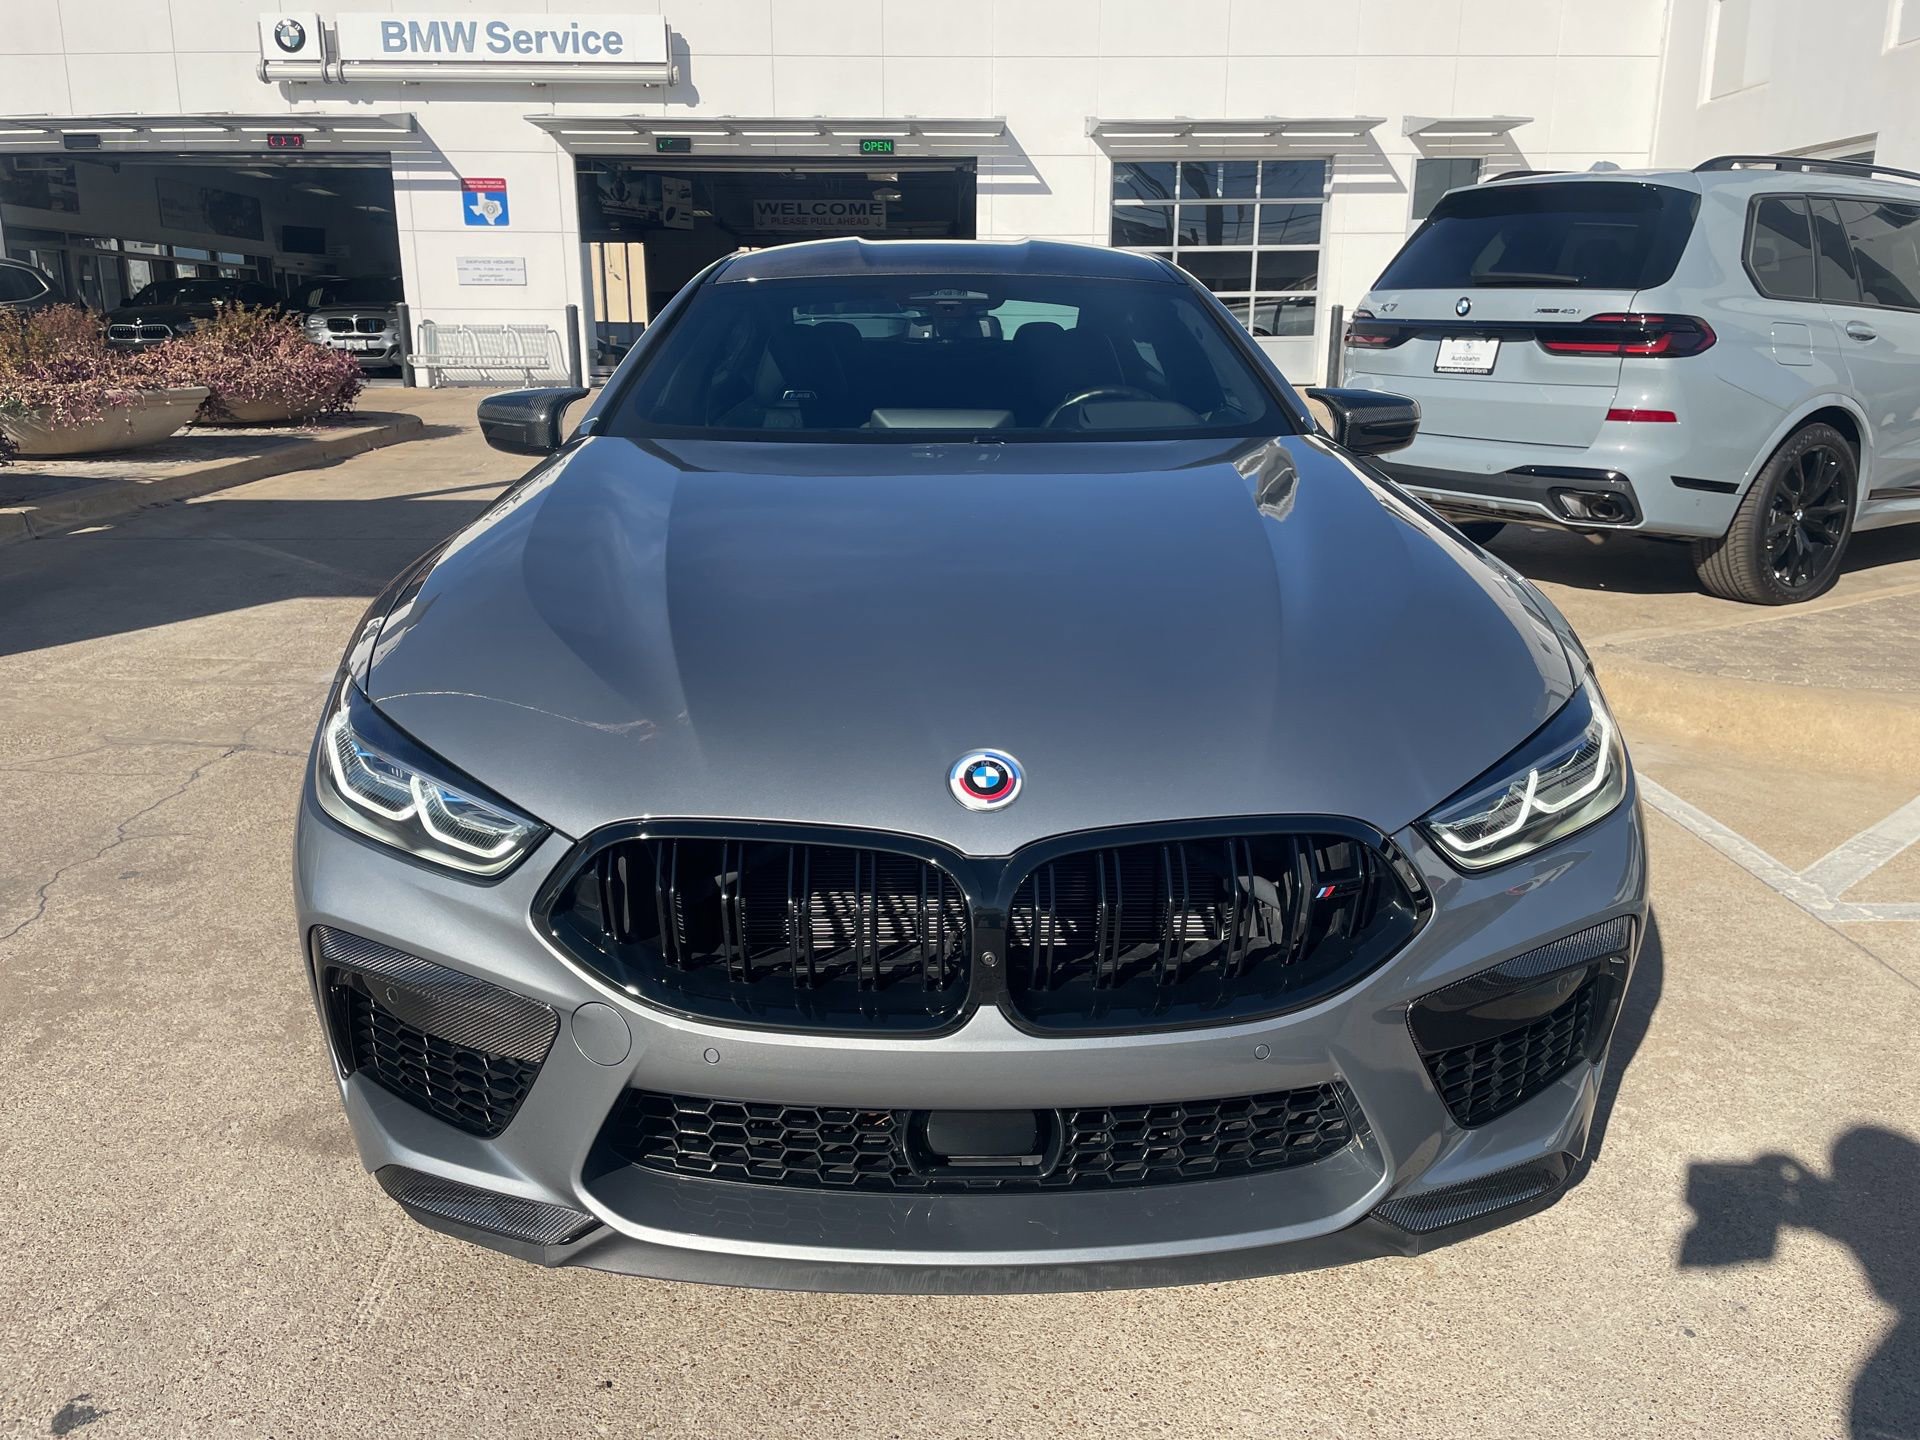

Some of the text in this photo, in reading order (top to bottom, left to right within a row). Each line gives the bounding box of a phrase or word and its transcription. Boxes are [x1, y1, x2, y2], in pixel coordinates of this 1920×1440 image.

[380, 20, 624, 55] BMW Service
[862, 141, 893, 152] OPEN
[757, 202, 883, 216] WELCOME
[770, 216, 870, 227] PLEASE PULL AHEAD
